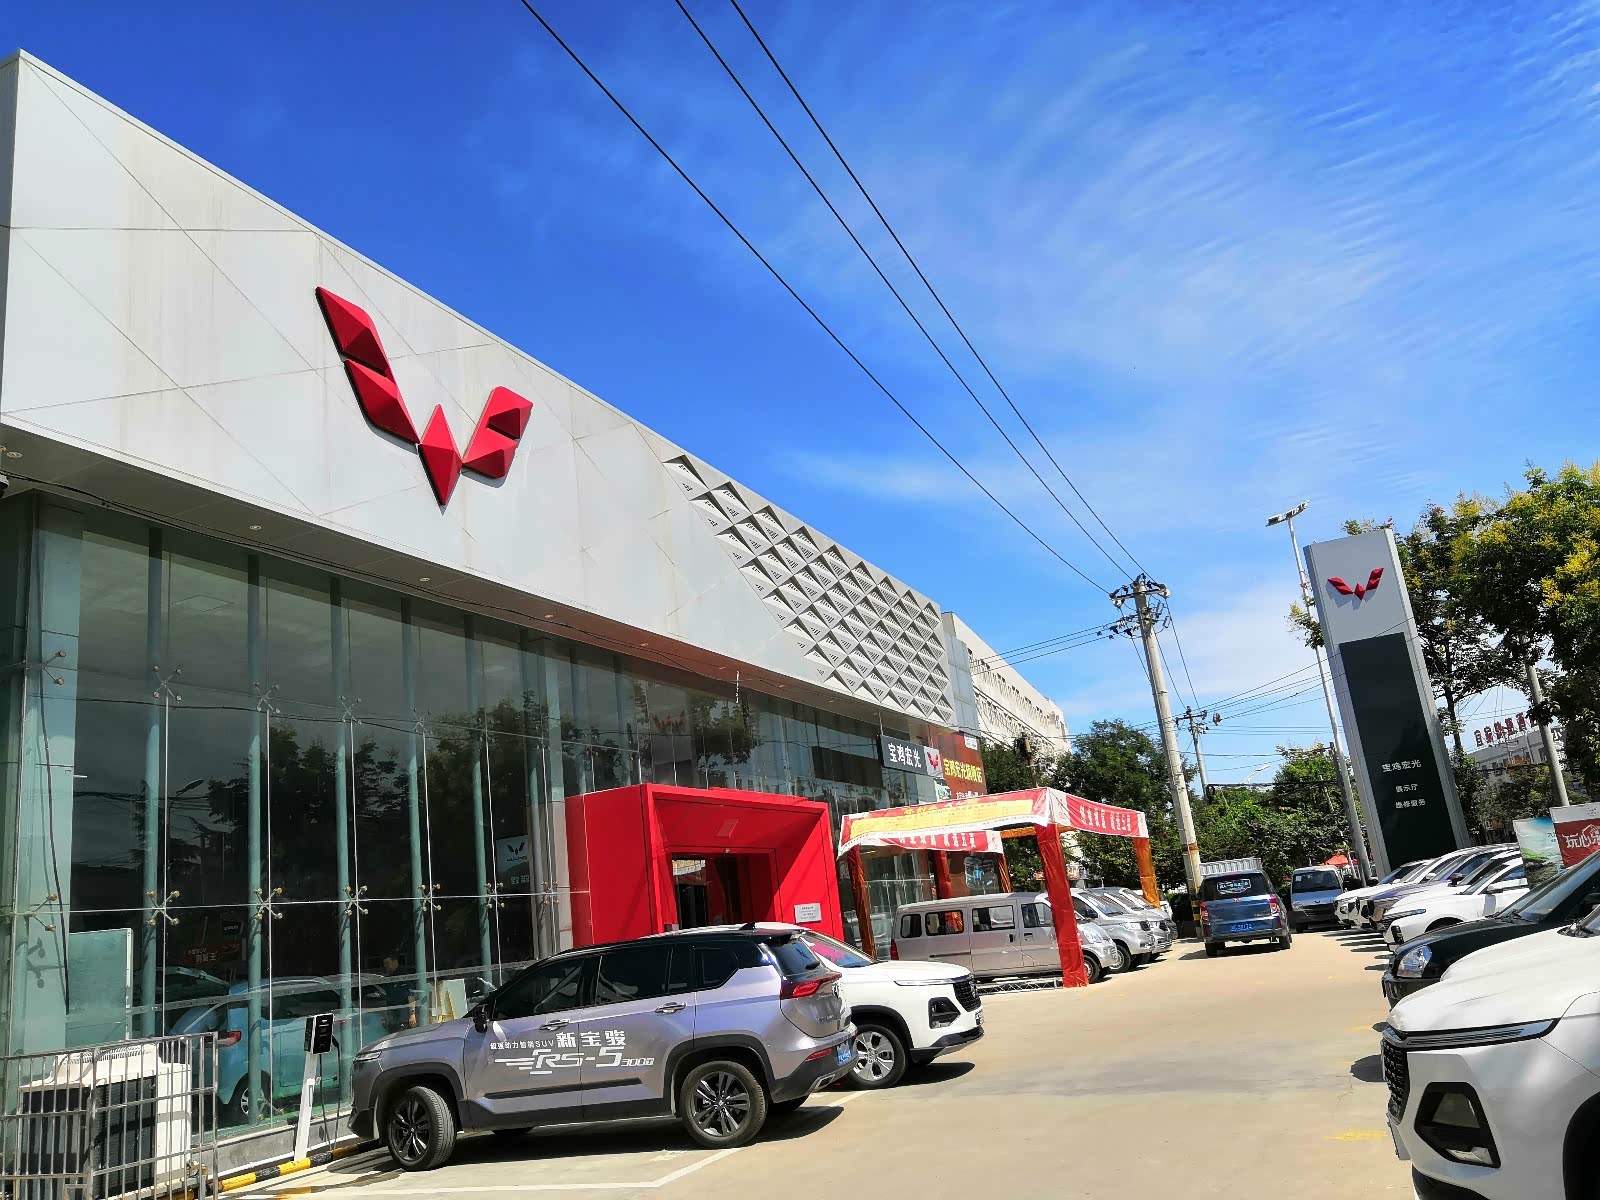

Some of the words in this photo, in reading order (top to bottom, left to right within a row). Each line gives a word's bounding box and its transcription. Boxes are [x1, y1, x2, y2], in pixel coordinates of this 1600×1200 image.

[888, 742, 921, 768] 宝鸡宏光
[1382, 760, 1421, 772] 宝鸡宏光
[1396, 784, 1418, 792] 展示厅
[556, 1029, 626, 1048] 新宝骏
